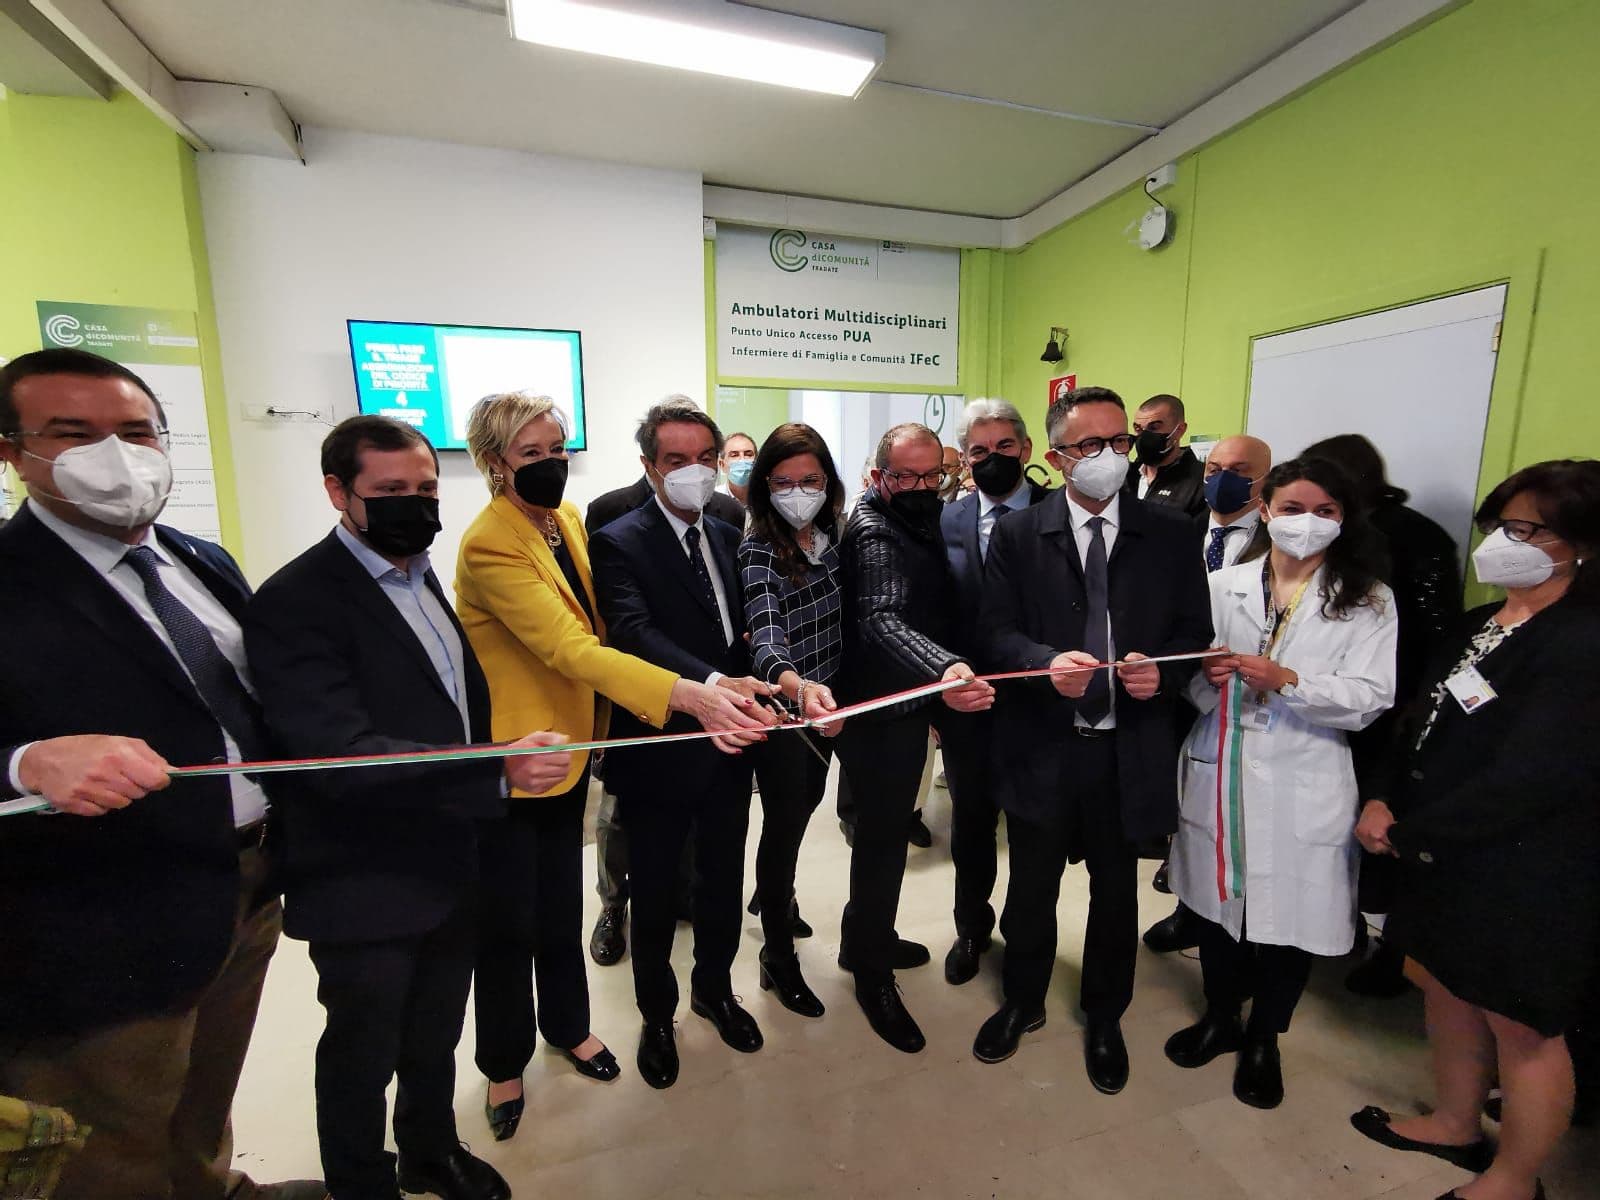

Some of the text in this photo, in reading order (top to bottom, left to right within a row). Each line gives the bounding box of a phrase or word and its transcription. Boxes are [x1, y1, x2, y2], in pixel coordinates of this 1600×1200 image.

[811, 241, 836, 251] CASA
[731, 302, 947, 330] Ambulatori Multidisciplinari
[84, 324, 108, 332] CASA
[731, 326, 872, 343] Punto Unico Accesso PUA
[732, 346, 788, 358] Infermiere
[792, 349, 802, 359] di
[805, 350, 848, 363] Famiglia
[860, 353, 906, 364] Comunità
[910, 353, 941, 366] IFeC
